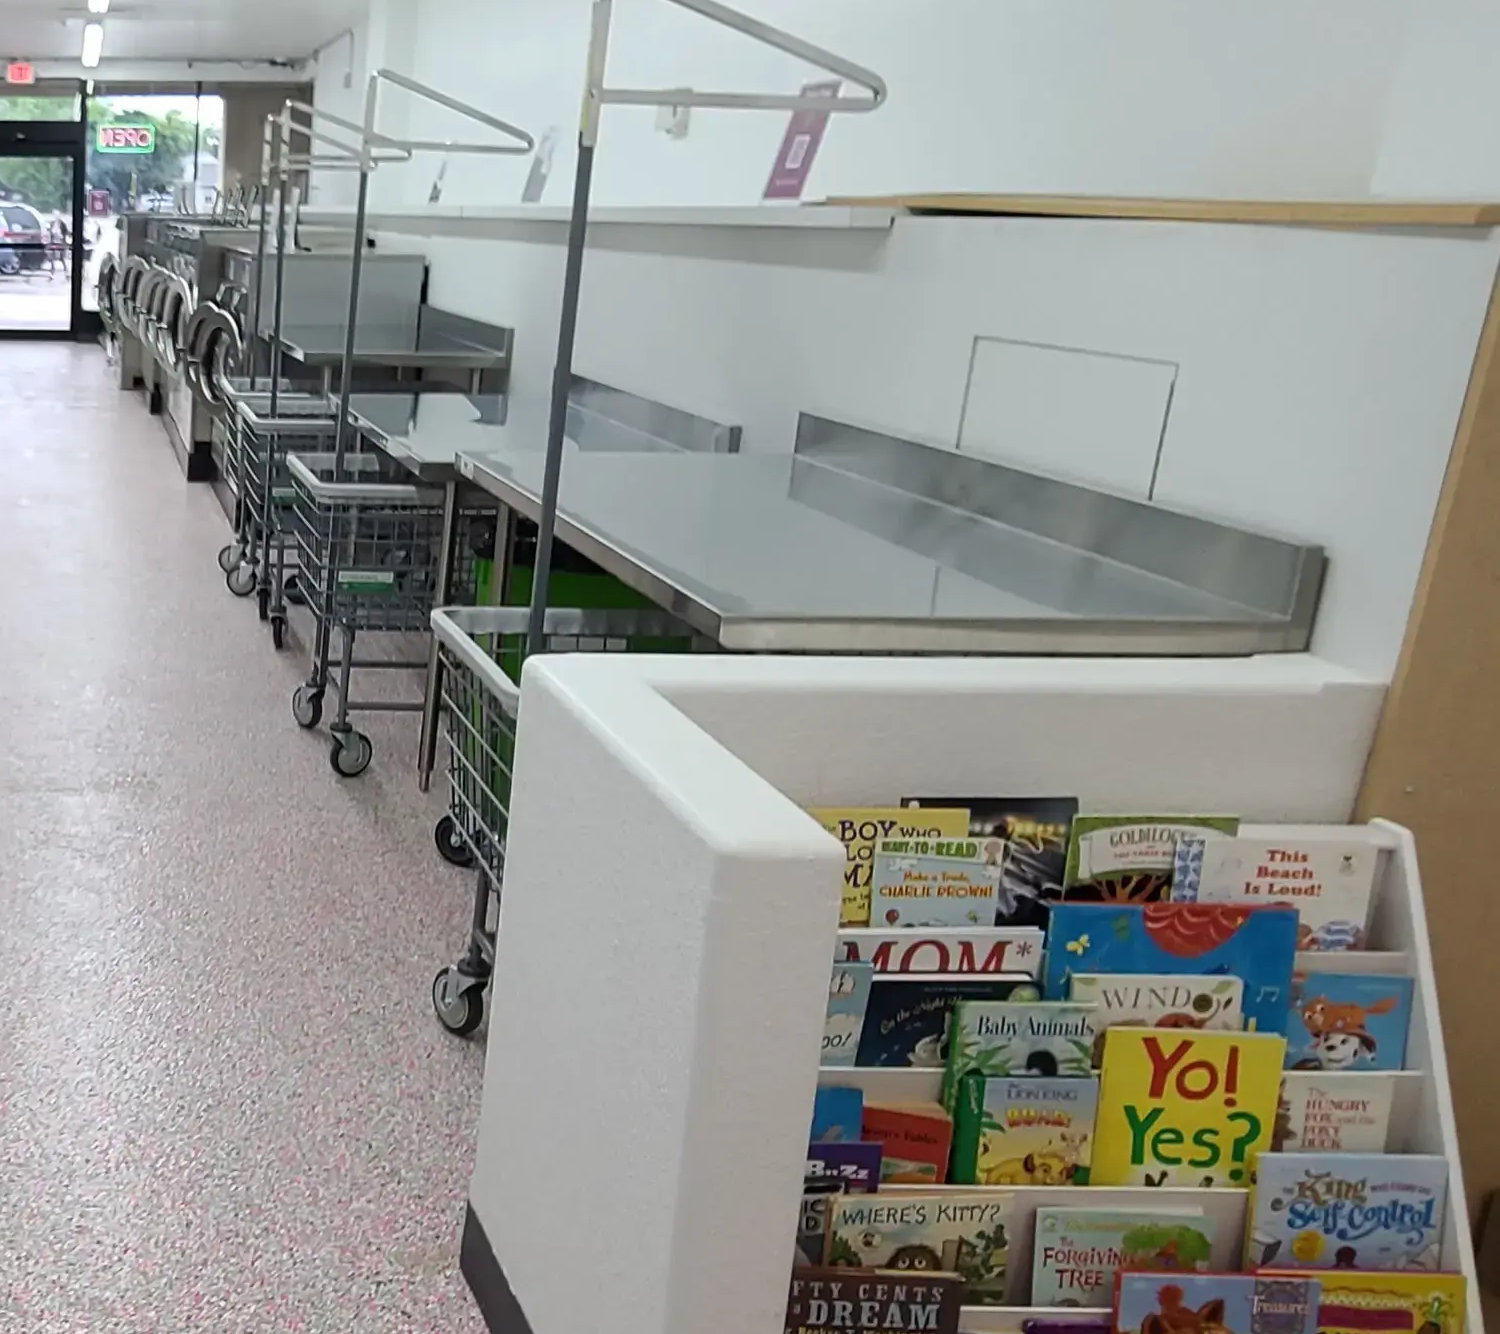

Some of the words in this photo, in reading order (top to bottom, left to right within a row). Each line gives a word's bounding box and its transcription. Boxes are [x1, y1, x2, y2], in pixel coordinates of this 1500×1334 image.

[838, 820, 897, 841] BOY
[1266, 849, 1309, 863] This
[1256, 866, 1314, 880] Beach
[1244, 882, 1261, 895] Is
[1268, 883, 1322, 897] Loud!
[976, 1015, 1018, 1041] Baby
[1027, 1014, 1095, 1037] Animals
[1142, 1036, 1239, 1107] Yo!
[1123, 1104, 1261, 1181] Yes?
[842, 1204, 927, 1225] WHERE'S
[936, 1203, 1001, 1223] KITTY?
[1055, 1269, 1105, 1291] TREE
[859, 1283, 944, 1302] CENTS
[807, 1299, 940, 1330] DREAM
